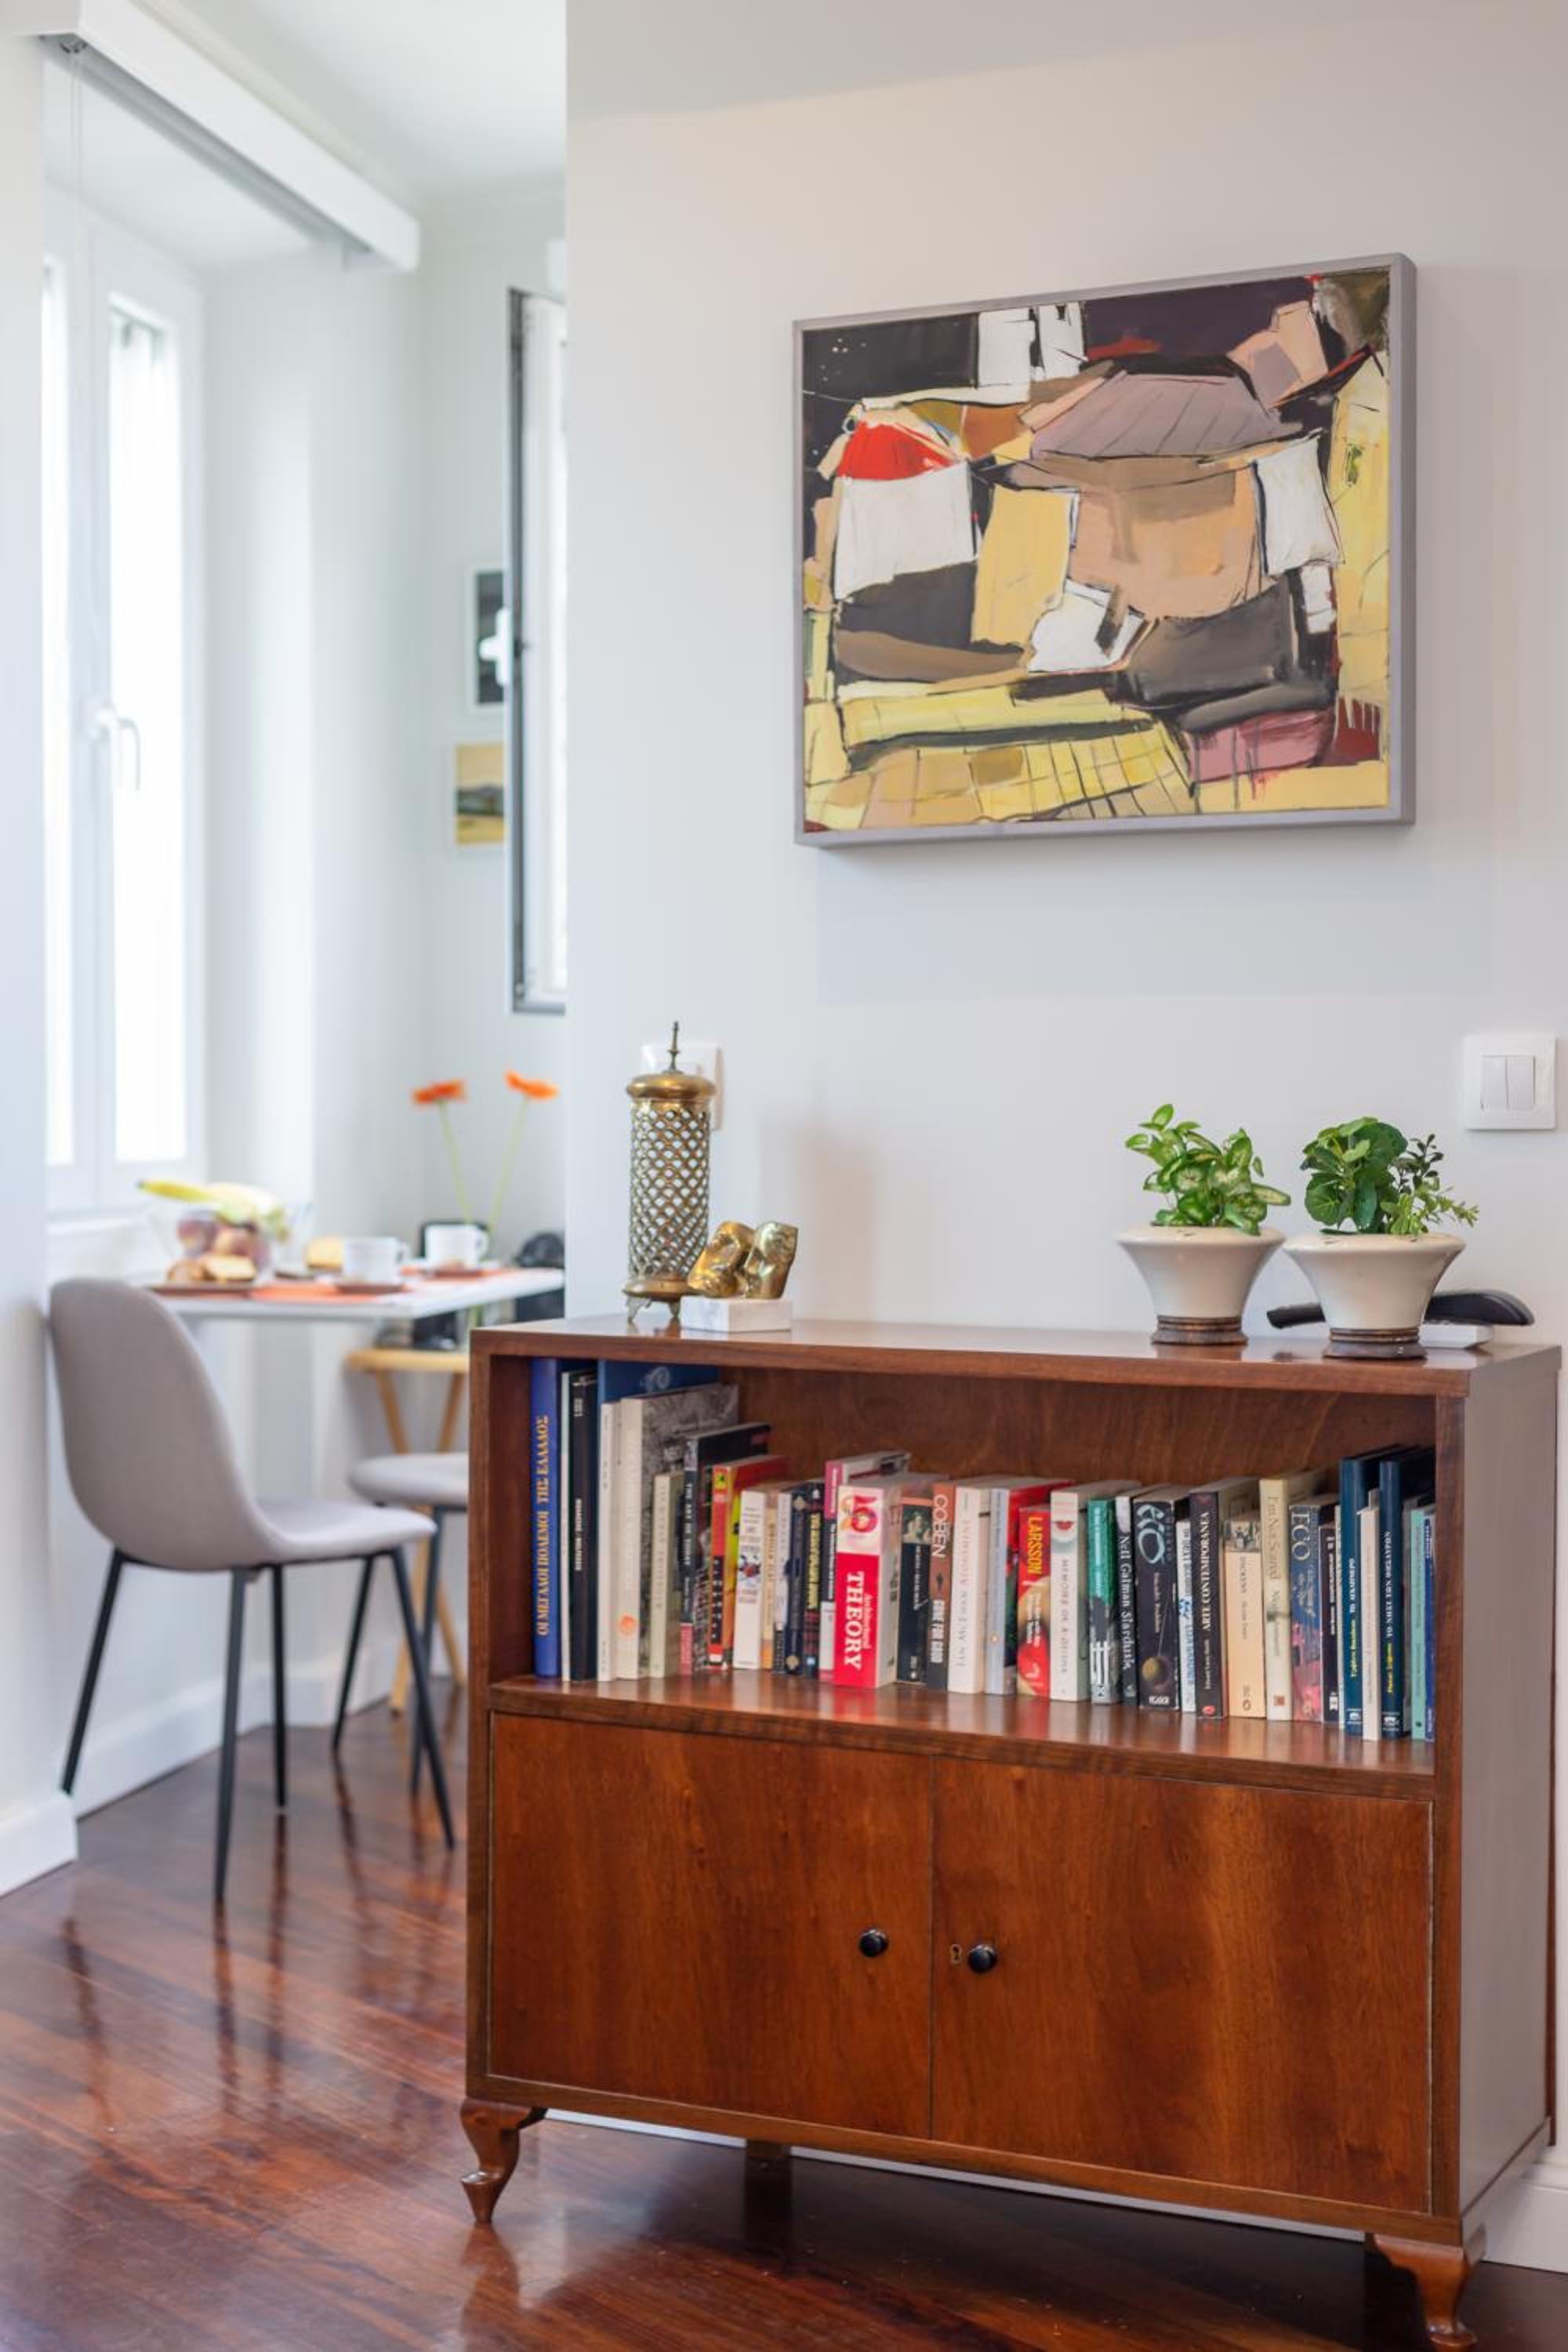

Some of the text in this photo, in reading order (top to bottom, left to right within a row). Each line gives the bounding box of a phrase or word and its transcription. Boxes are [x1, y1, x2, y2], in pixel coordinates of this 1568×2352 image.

[932, 1494, 949, 1558] COBEN
[1028, 1517, 1044, 1575] LARSSON
[1120, 1535, 1132, 1560] Neil
[1291, 1511, 1311, 1561] ECO
[1120, 1563, 1132, 1607] Gaiman
[844, 1570, 865, 1671] THEORY
[1202, 1605, 1211, 1632] ARTE
